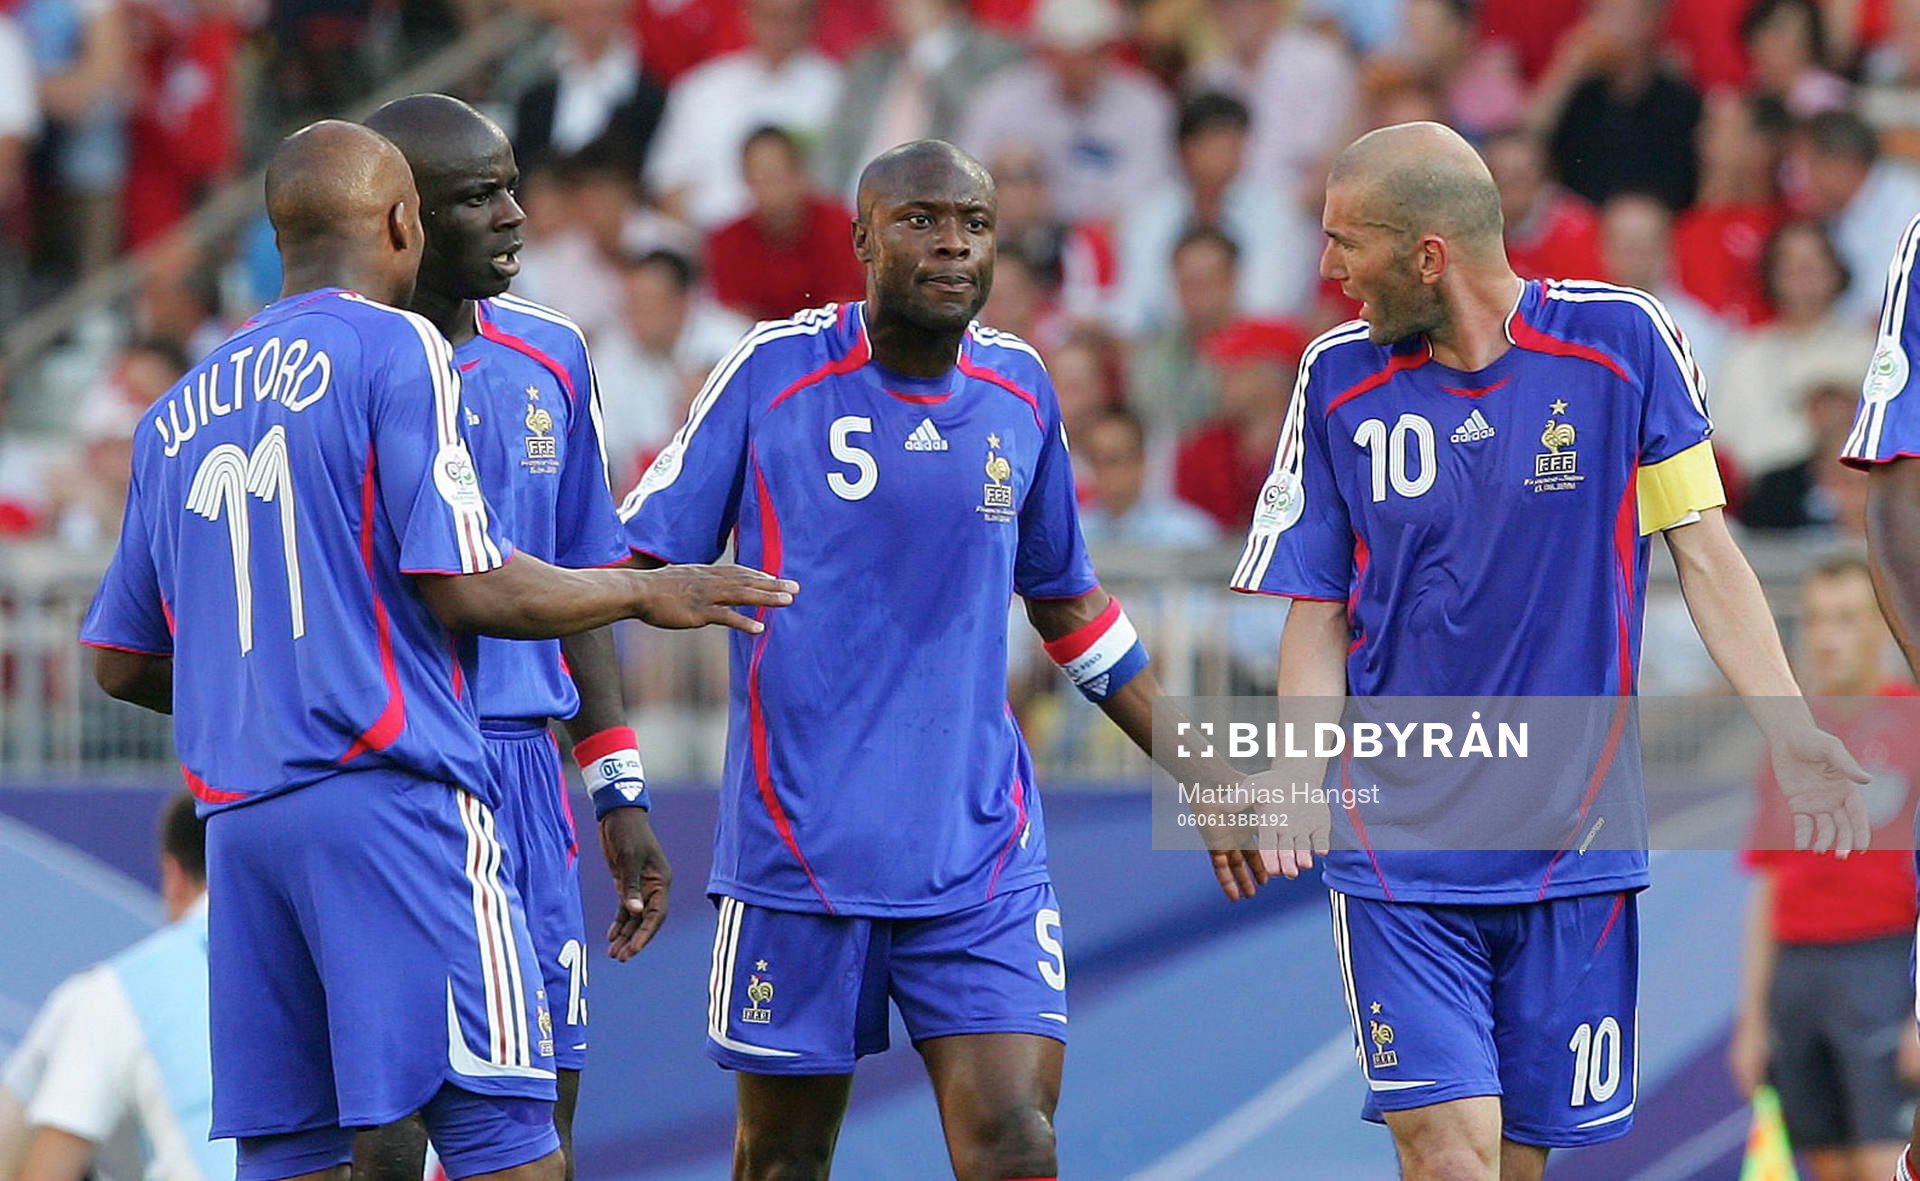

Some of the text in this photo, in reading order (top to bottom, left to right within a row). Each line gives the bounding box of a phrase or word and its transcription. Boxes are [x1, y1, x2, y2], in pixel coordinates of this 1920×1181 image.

[154, 336, 332, 458] WILTORD
[1450, 427, 1496, 443] adidas
[826, 415, 879, 501] 5
[1353, 413, 1436, 502] 10
[185, 424, 304, 657] 11
[1035, 908, 1066, 991] 5
[1568, 1016, 1621, 1105] 10
